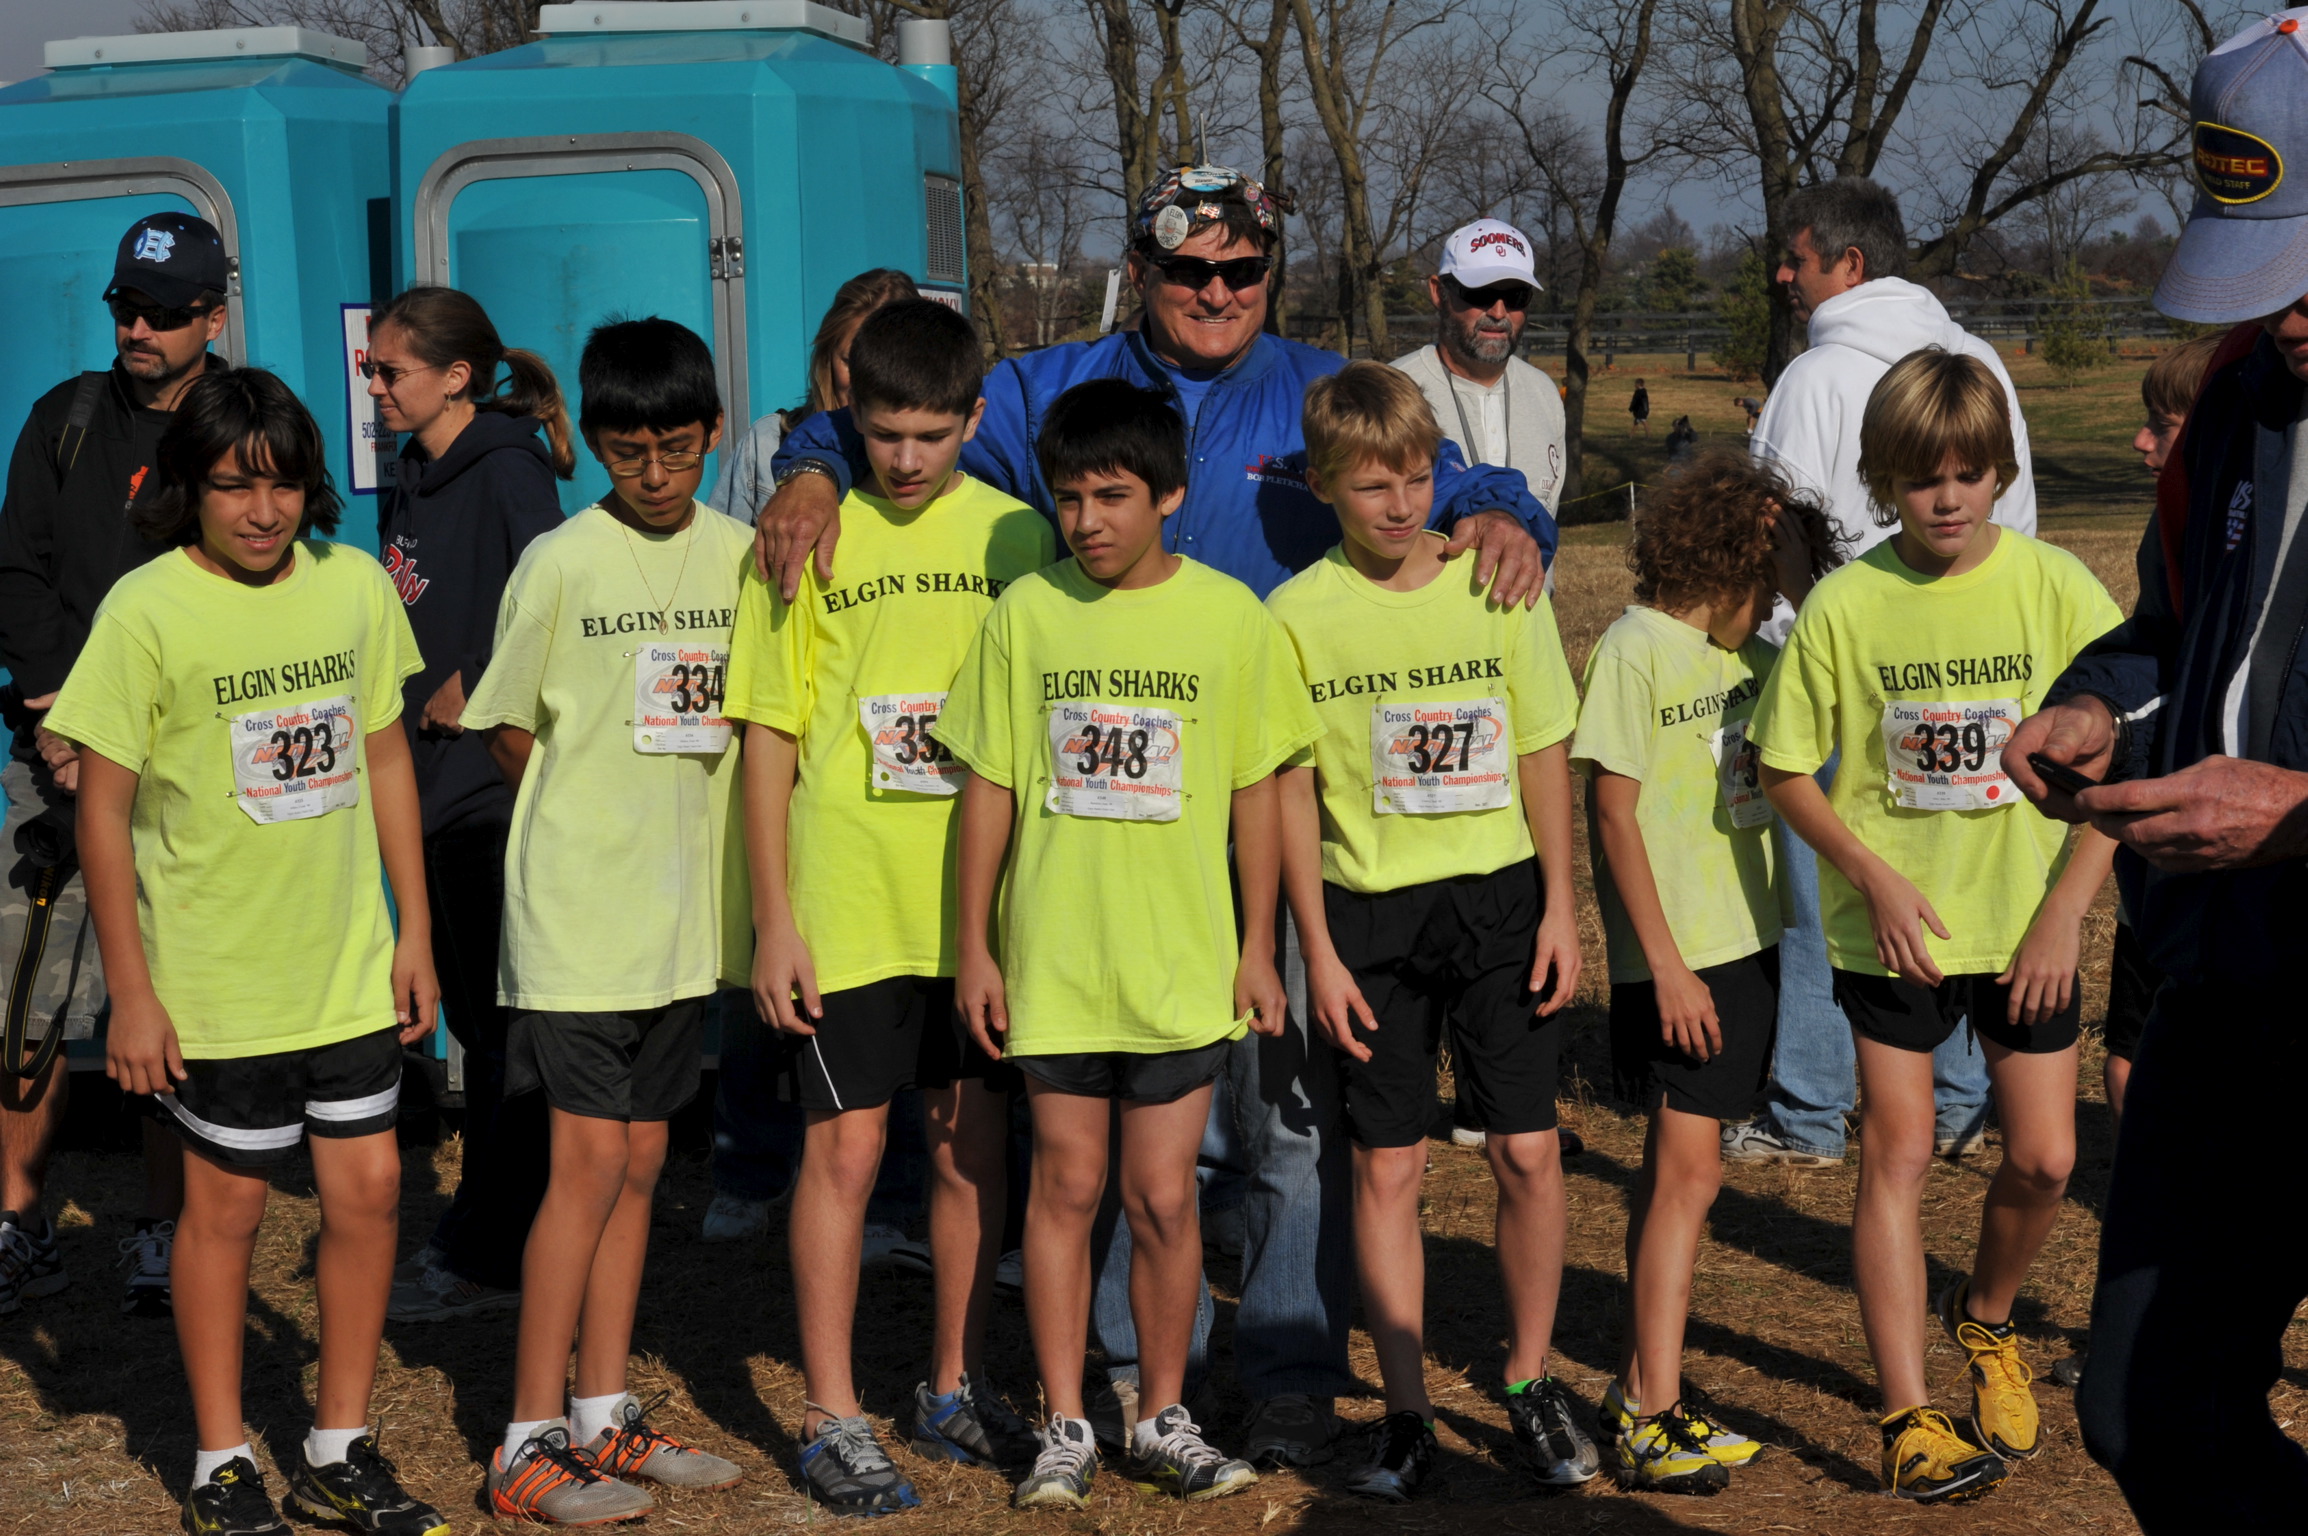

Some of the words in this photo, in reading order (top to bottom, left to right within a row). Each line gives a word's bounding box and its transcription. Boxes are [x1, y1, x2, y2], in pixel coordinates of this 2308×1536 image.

[1470, 232, 1526, 258] SOONERS
[1495, 245, 1507, 258] OU
[822, 574, 906, 614] ELGIN
[916, 572, 1010, 599] SHARK
[580, 611, 664, 637] ELGIN
[674, 608, 737, 630] SHAR
[651, 648, 676, 662] Cross
[678, 649, 709, 664] Country
[213, 667, 277, 705] ELGIN
[281, 649, 356, 693] SHARKS
[1042, 669, 1102, 702] ELGIN
[1108, 669, 1200, 703] SHARKS
[1878, 662, 1942, 691] ELGIN
[1946, 653, 2033, 687] SHARKS
[671, 664, 724, 713] 334
[1309, 672, 1398, 703] ELGIN
[245, 718, 273, 732] Cross
[276, 712, 310, 728] Country
[312, 704, 346, 720] Coaches
[644, 715, 678, 726] National
[680, 715, 700, 726] Youth
[871, 702, 897, 715] Cross
[900, 699, 937, 714] Country
[1063, 707, 1088, 721] Cross
[1091, 709, 1130, 727] Country
[1133, 713, 1173, 729] Coaches
[1384, 710, 1412, 723] Cross
[1414, 708, 1453, 723] Country
[1456, 706, 1492, 720] Coaches
[1659, 693, 1721, 727] ELGIN
[1894, 706, 1919, 721] Cross
[1922, 708, 1961, 723] Country
[1965, 706, 2007, 720] Coaches
[271, 722, 336, 781] 323
[1077, 724, 1149, 779] 348
[1408, 722, 1474, 774] 327
[1915, 722, 1986, 773] 339
[246, 784, 282, 798] National
[284, 780, 306, 794] Youth
[1085, 777, 1108, 790] Youth
[1110, 779, 1172, 797] Championships
[1382, 775, 1416, 787] National
[1417, 775, 1440, 786] Youth
[1443, 770, 1503, 786] Championships
[1897, 768, 1925, 783] National
[1926, 774, 1949, 785] Youth
